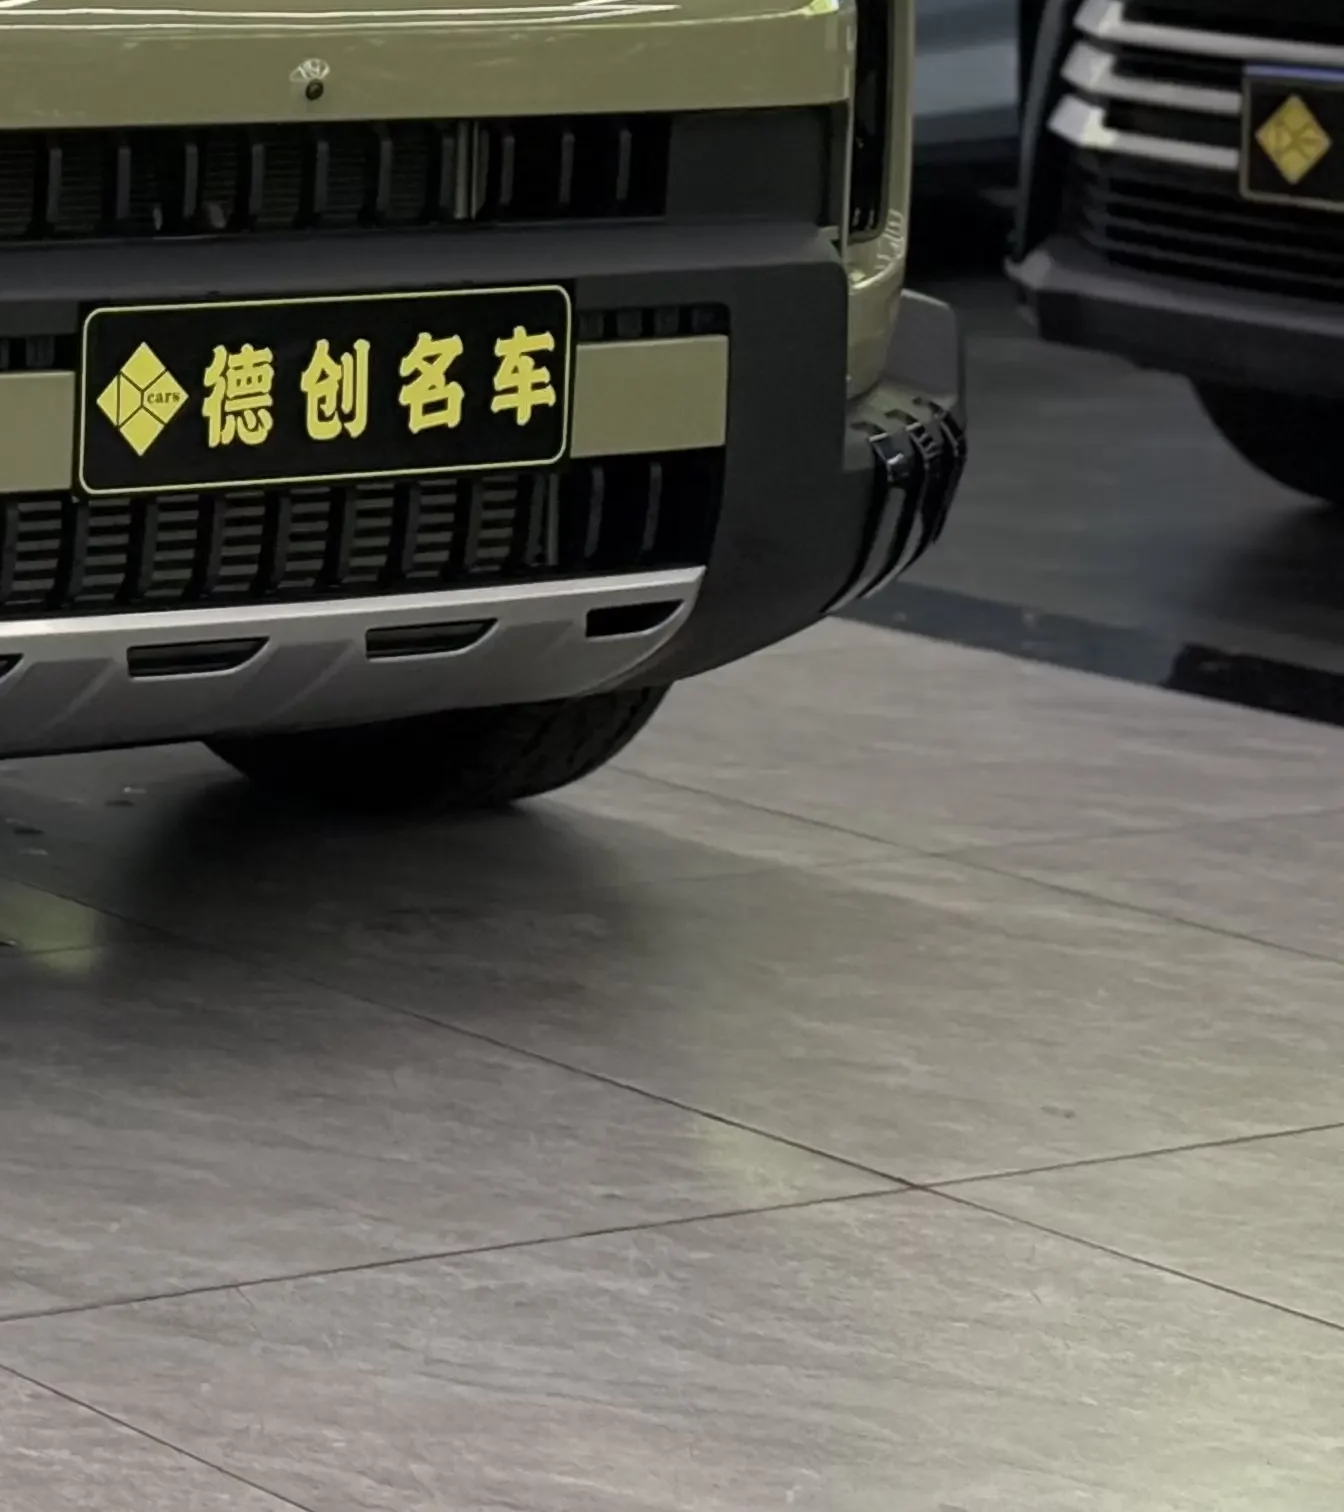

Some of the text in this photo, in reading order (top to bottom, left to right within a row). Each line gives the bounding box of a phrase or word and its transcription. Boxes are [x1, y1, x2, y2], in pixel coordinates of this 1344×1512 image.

[146, 390, 181, 405] cars
[200, 325, 557, 449] 德创名车
